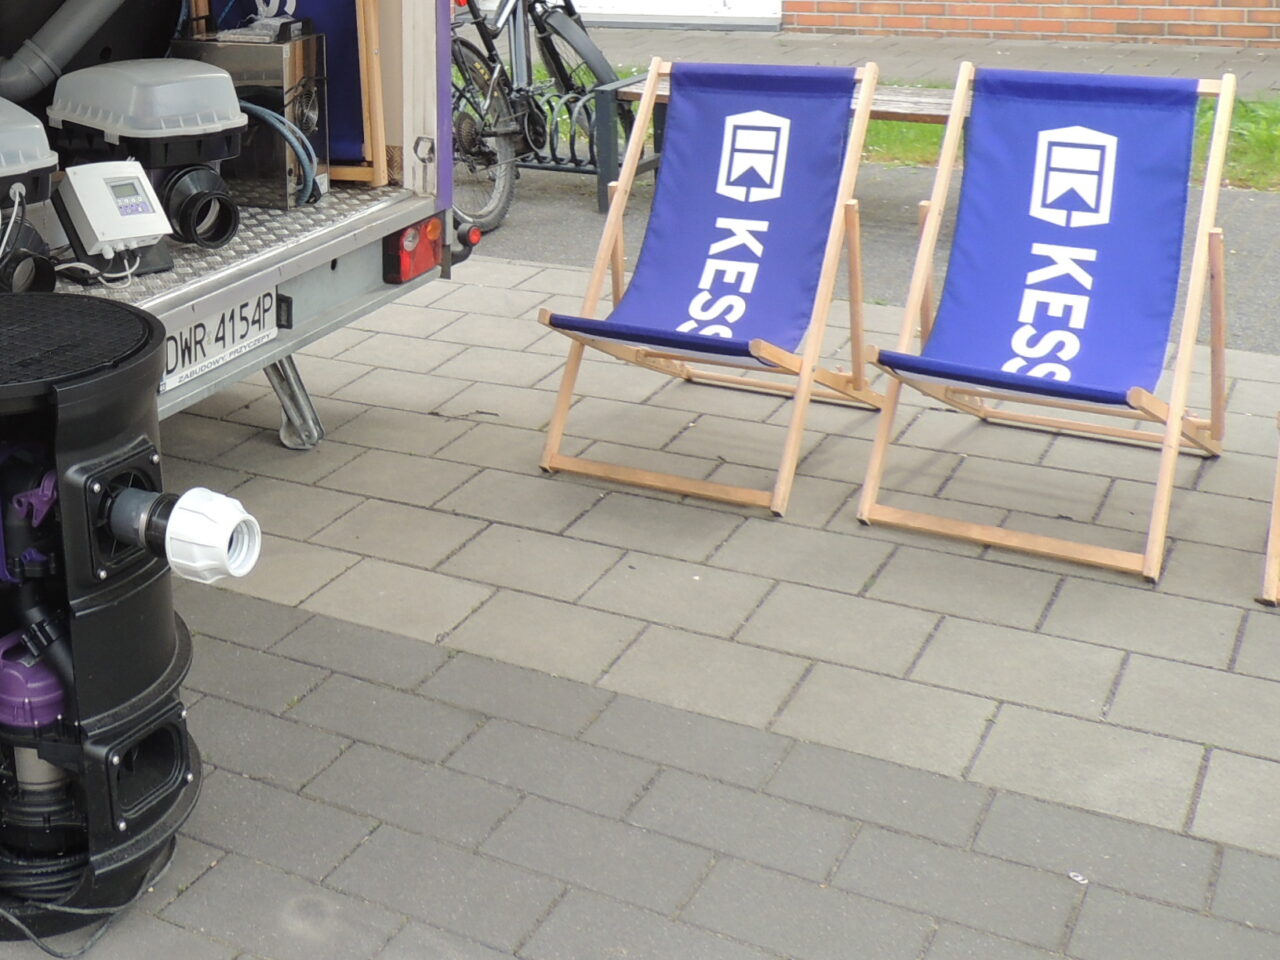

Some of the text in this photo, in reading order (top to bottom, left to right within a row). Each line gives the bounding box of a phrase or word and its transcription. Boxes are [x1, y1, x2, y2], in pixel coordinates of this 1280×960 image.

[166, 292, 273, 375] DWR 4154P
[229, 333, 272, 358] PRZYCZEPY
